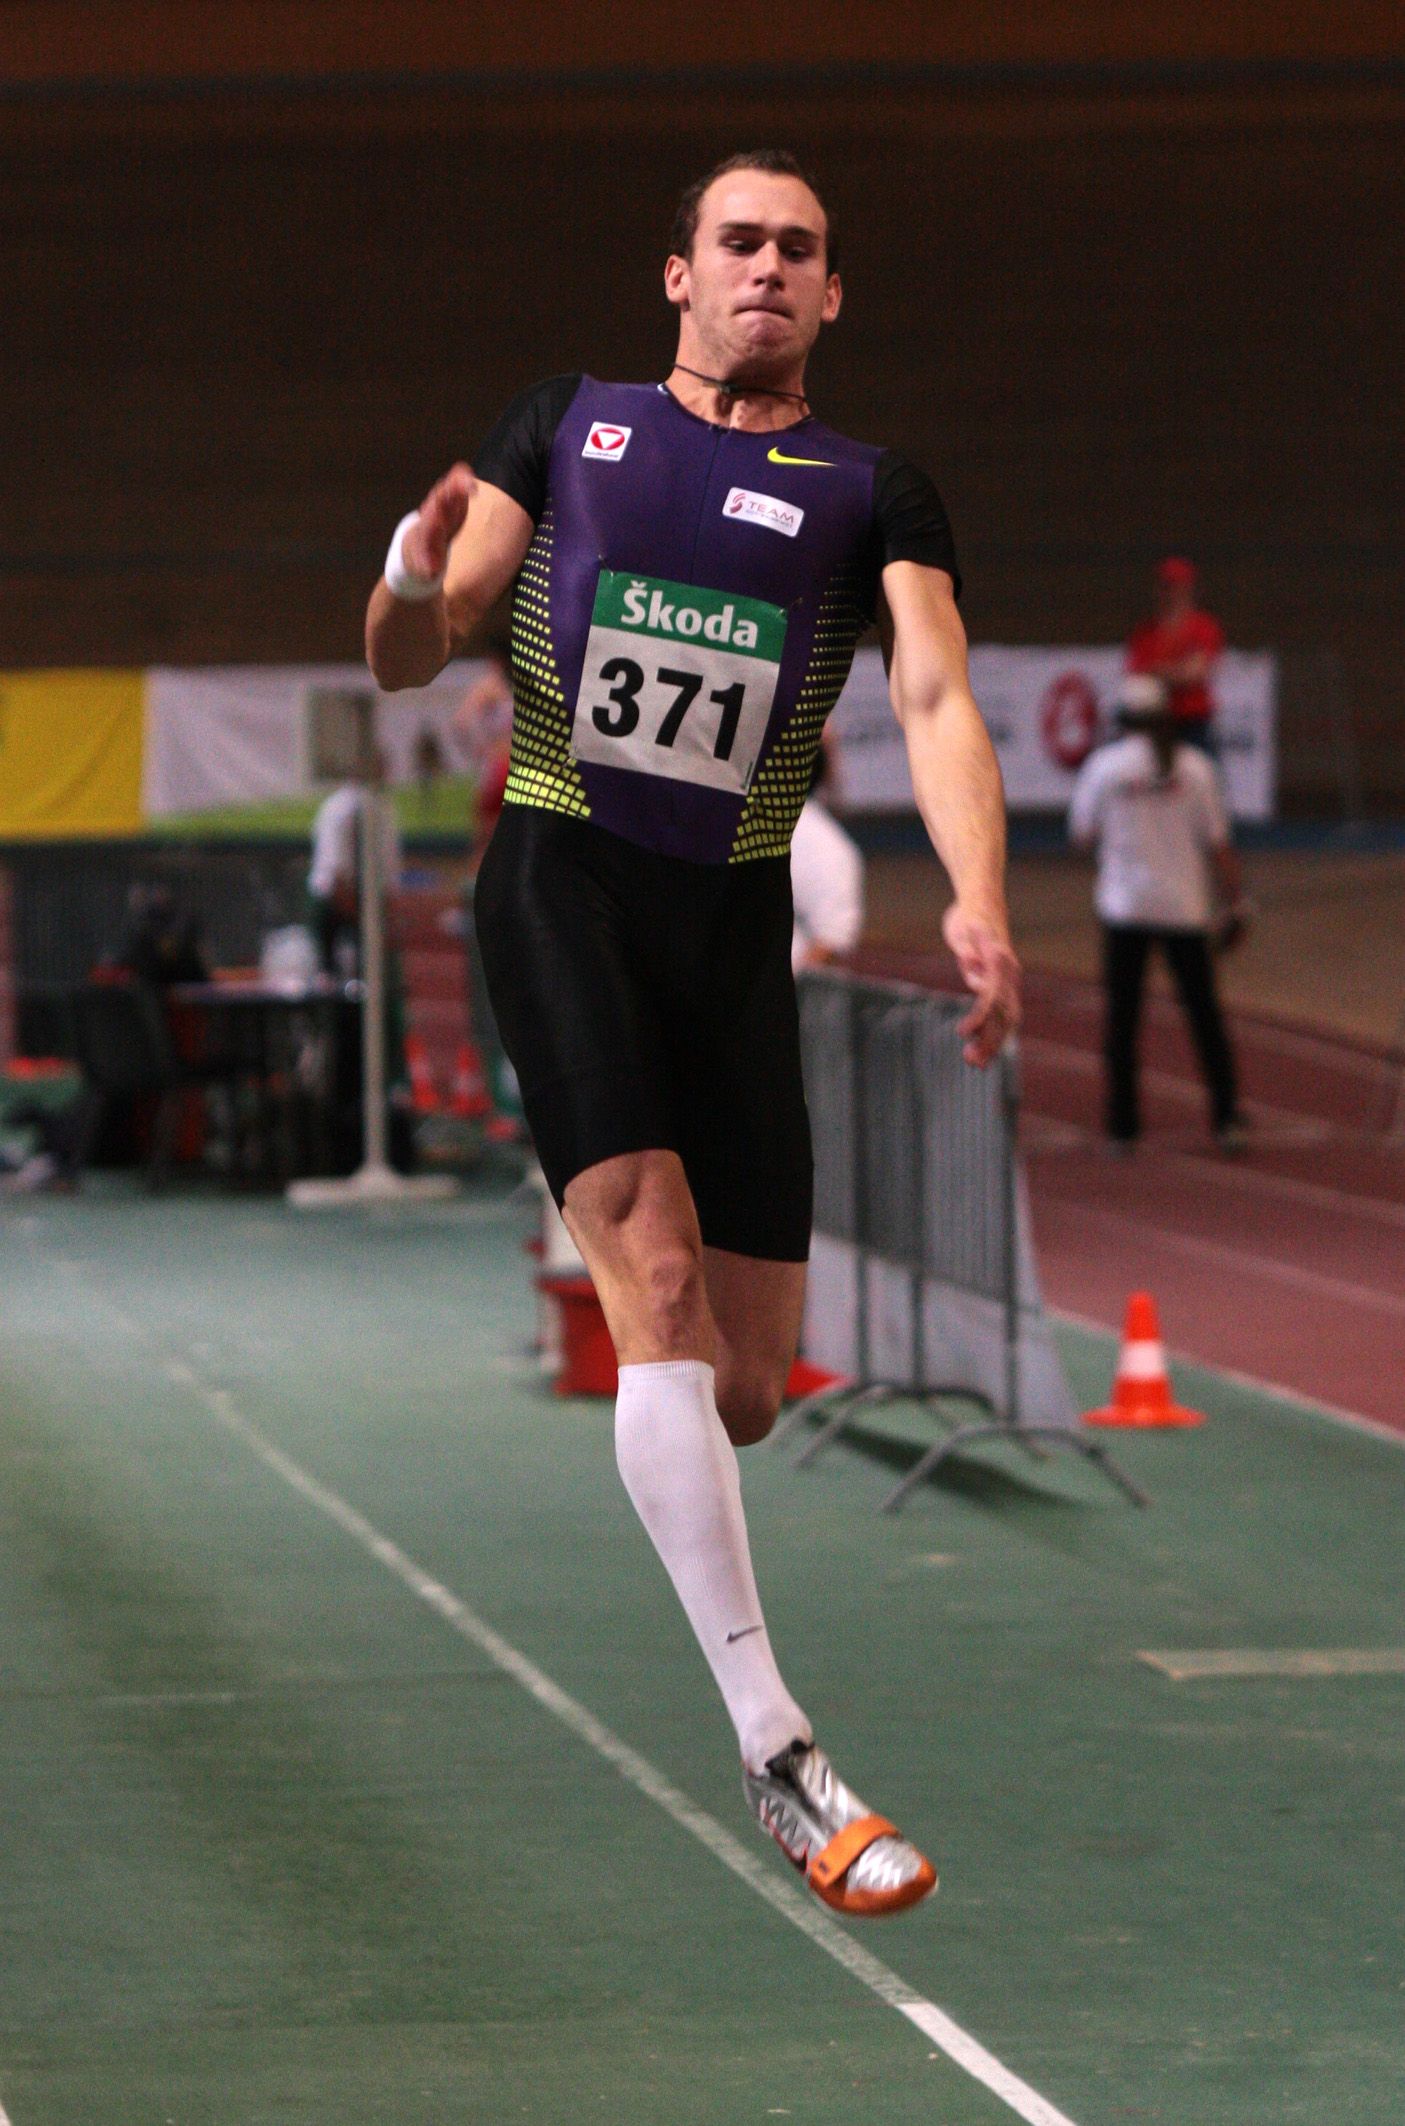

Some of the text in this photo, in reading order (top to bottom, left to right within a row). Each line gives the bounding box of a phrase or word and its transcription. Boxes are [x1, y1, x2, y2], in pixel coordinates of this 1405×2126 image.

[748, 501, 795, 524] TEAM
[620, 579, 759, 649] Škoda
[592, 657, 746, 761] 371
